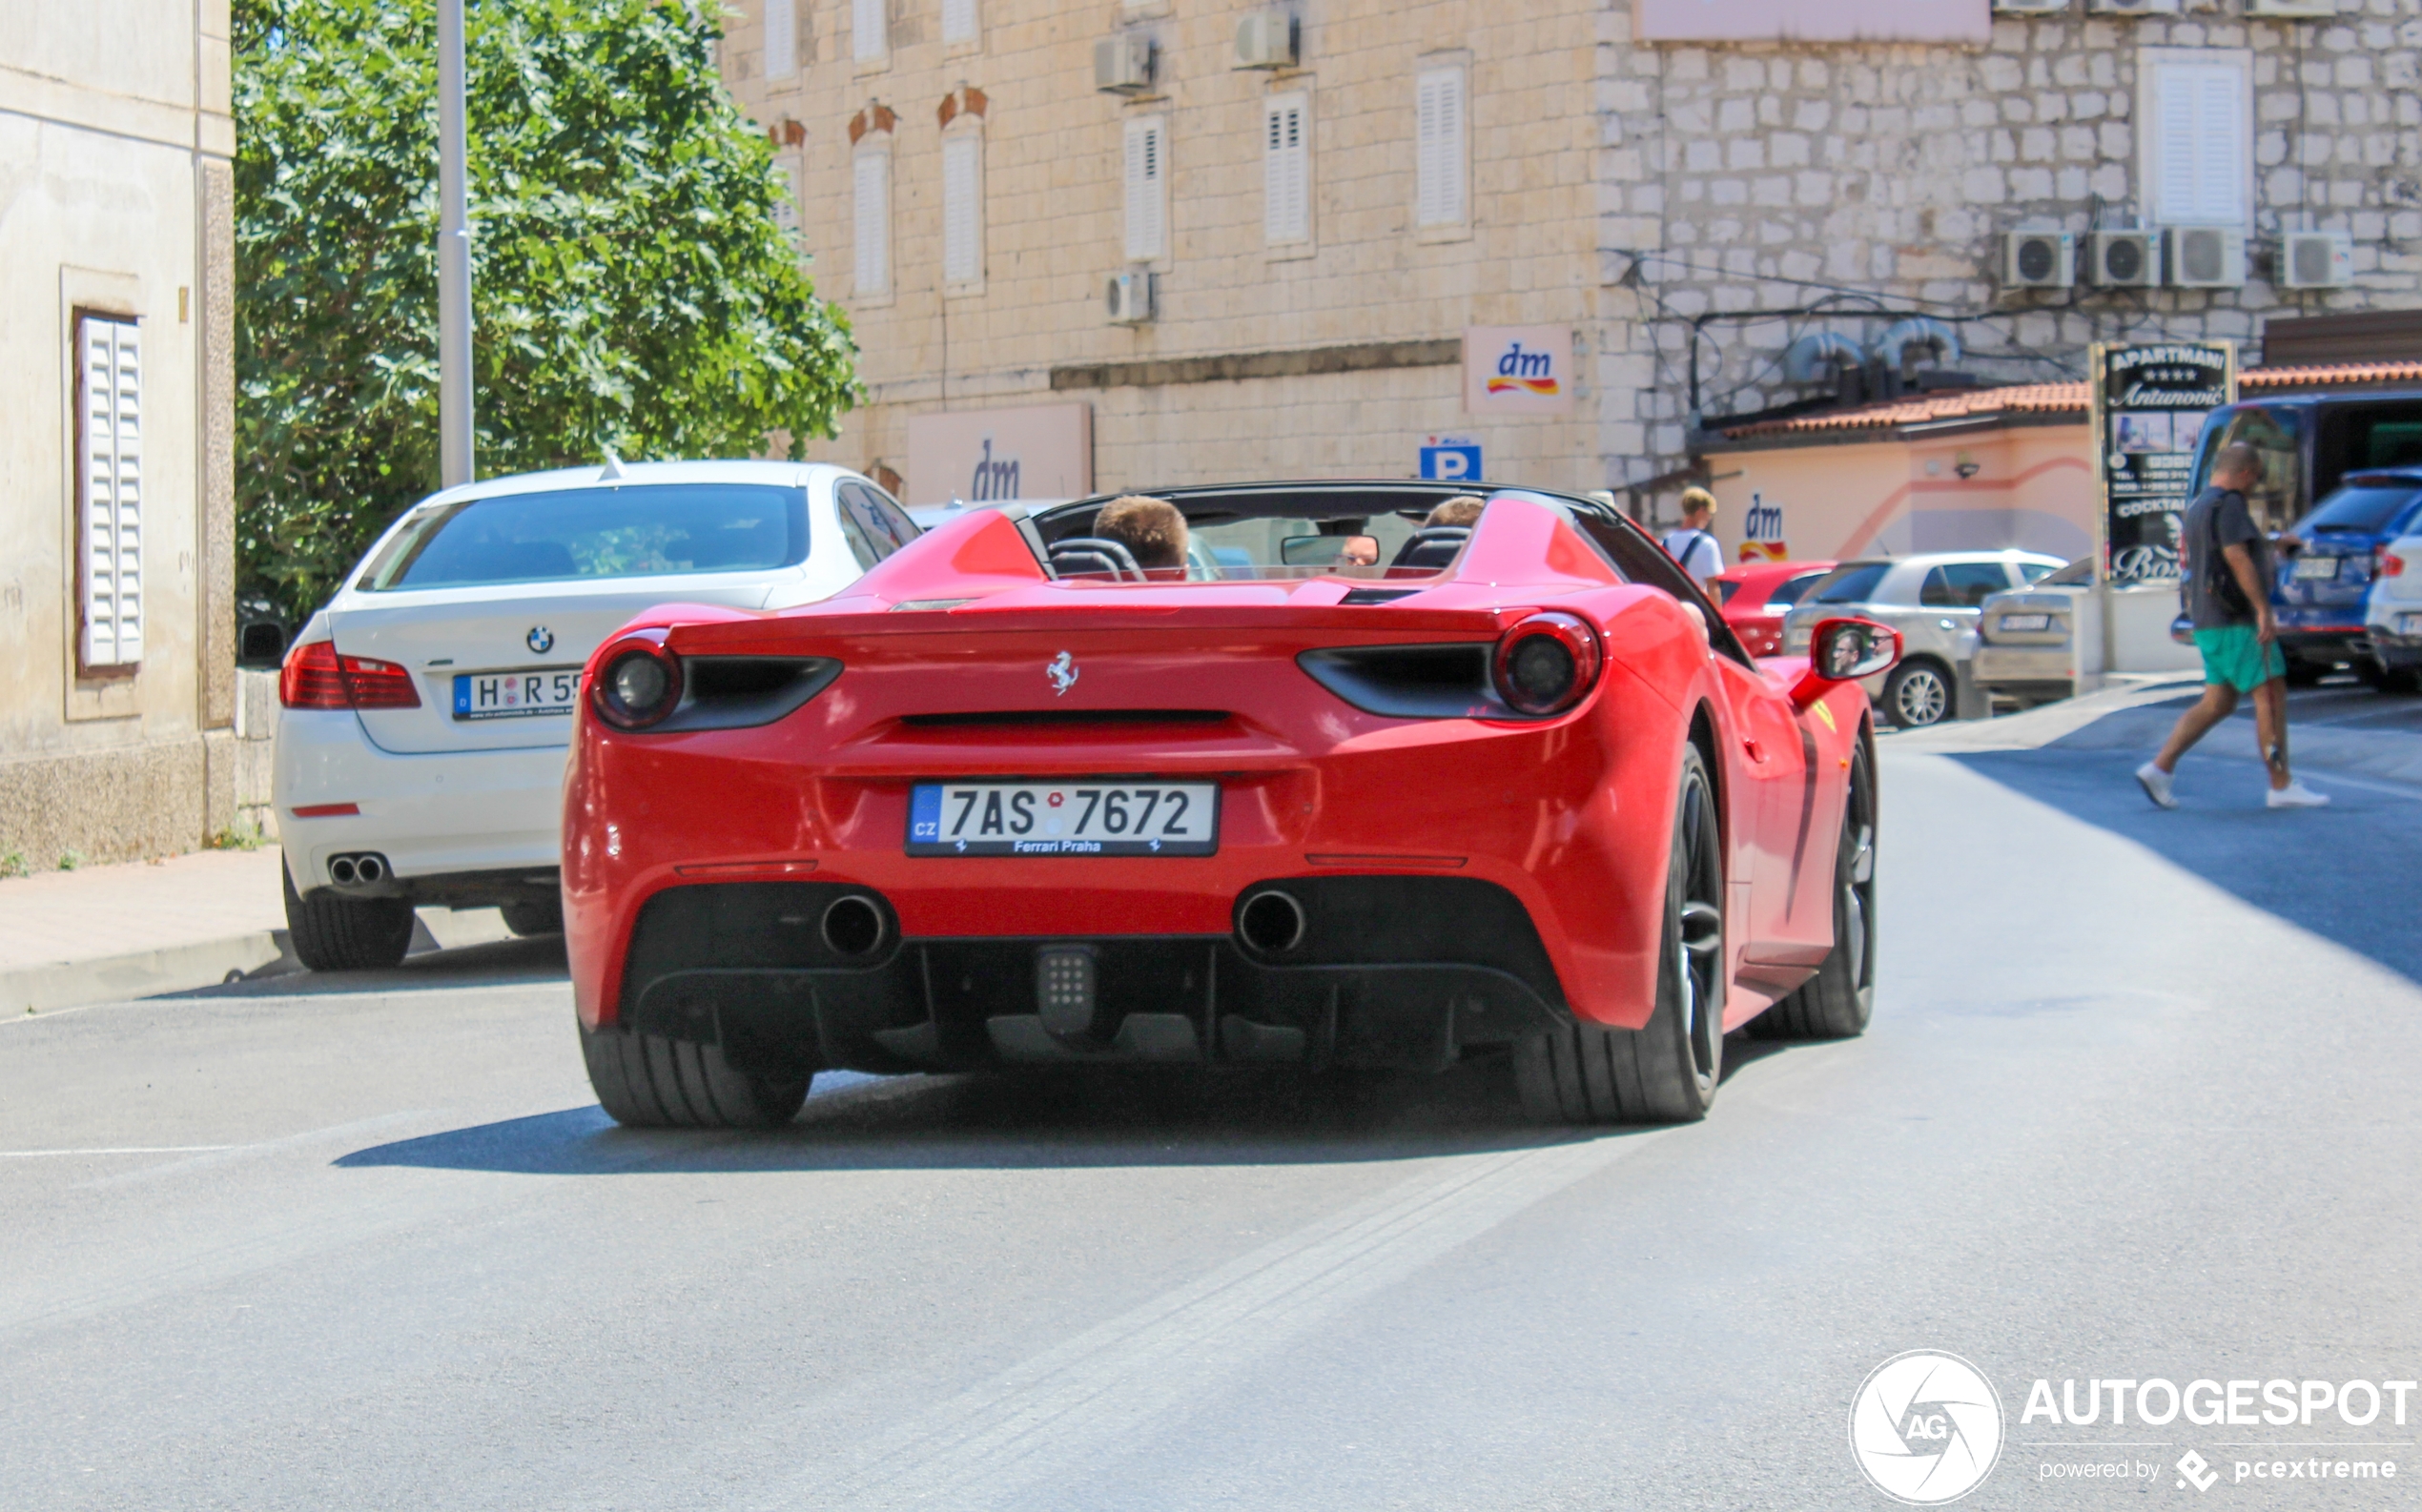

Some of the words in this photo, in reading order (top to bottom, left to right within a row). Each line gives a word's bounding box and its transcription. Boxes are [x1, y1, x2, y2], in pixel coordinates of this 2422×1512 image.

[1499, 342, 1550, 377] dm
[2111, 348, 2224, 372] APARTMANI
[973, 439, 1019, 501] dm
[1435, 451, 1468, 480] P
[1746, 493, 1782, 539] dm
[480, 678, 498, 706] H
[525, 677, 543, 704] R
[950, 789, 1036, 836] 7AS
[1074, 789, 1189, 836] 7672
[914, 822, 935, 836] CZ
[1014, 840, 1058, 853] Ferrari
[1062, 840, 1100, 853] Praha
